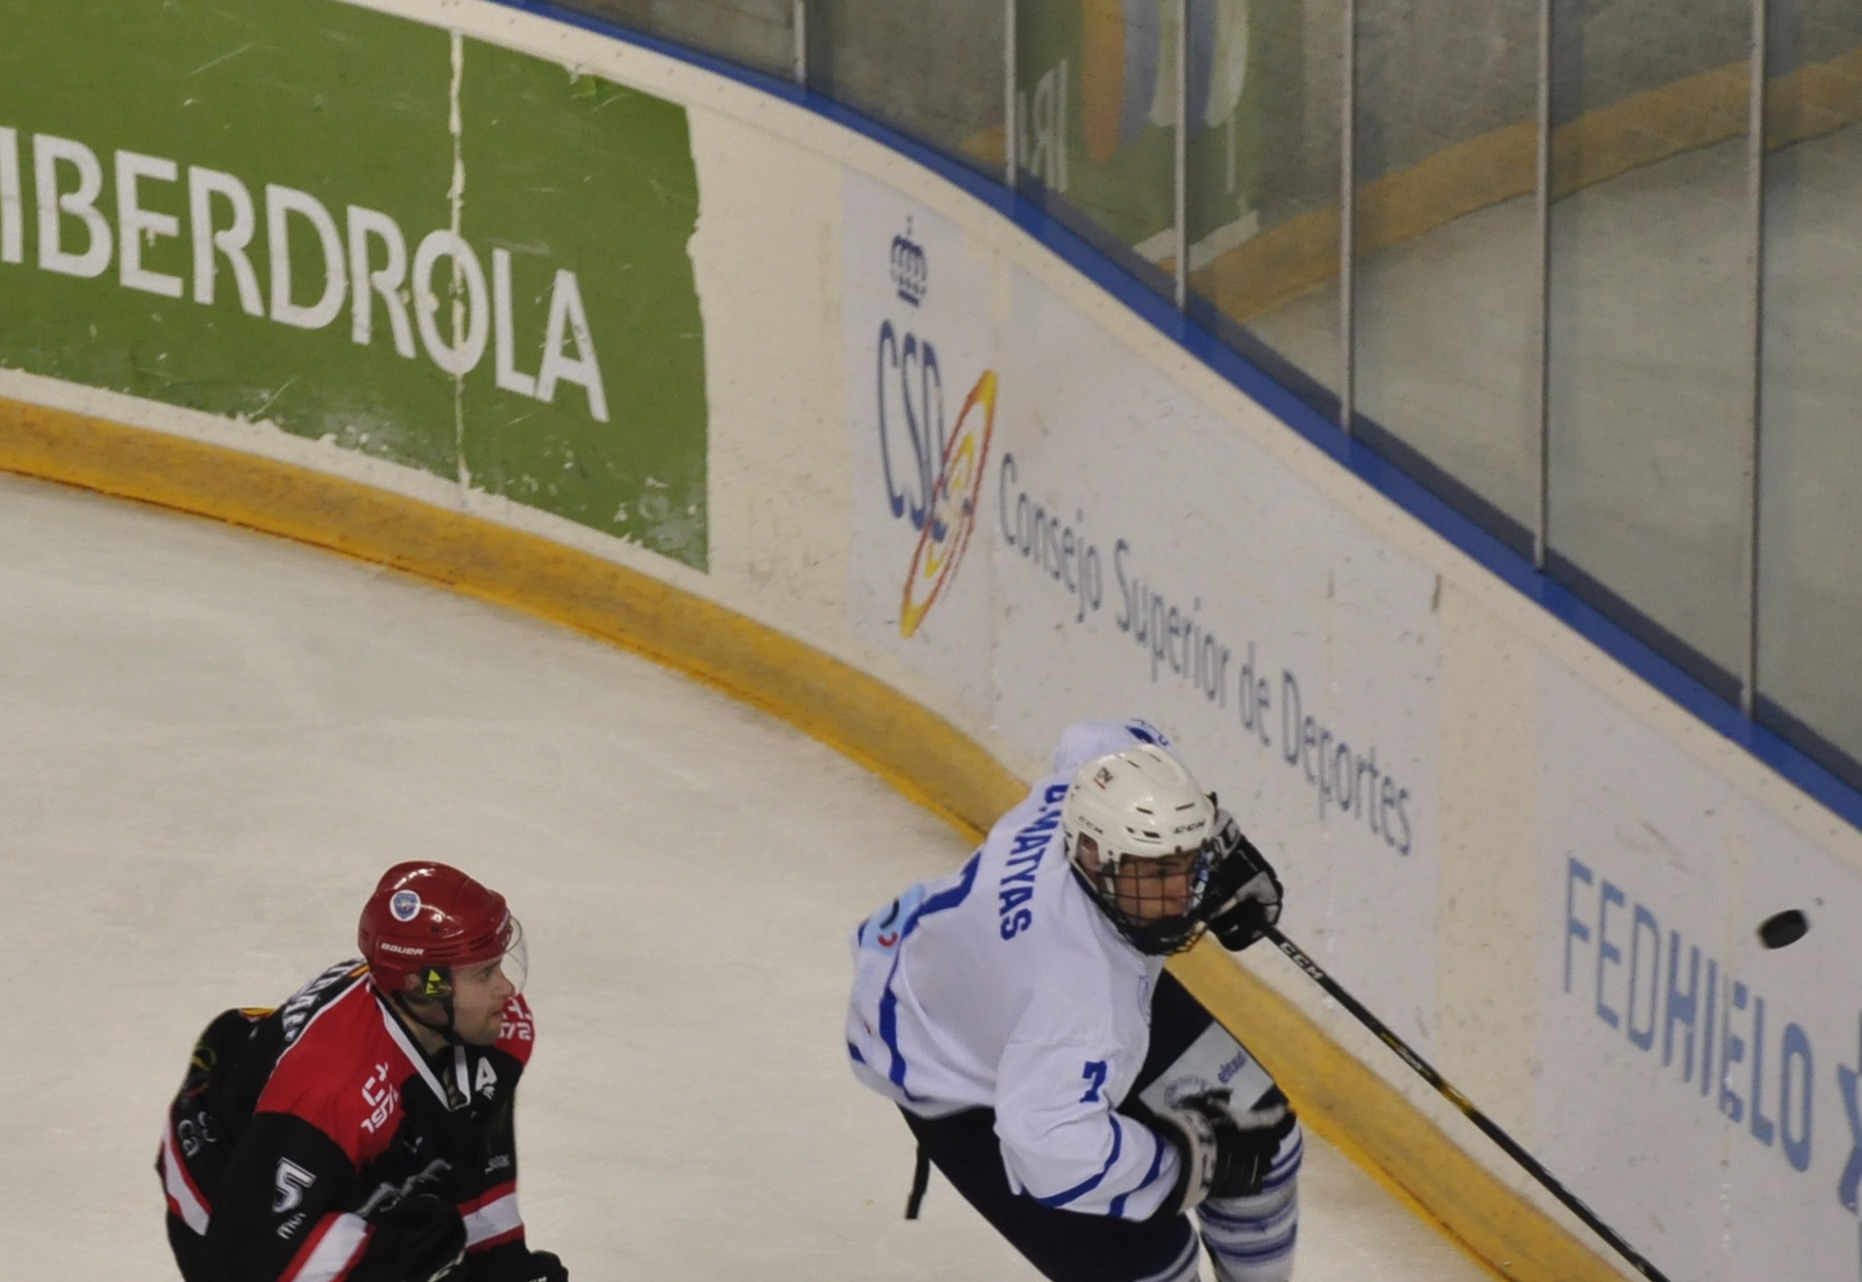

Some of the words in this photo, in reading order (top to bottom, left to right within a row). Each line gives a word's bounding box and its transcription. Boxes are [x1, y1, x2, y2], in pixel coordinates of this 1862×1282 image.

[877, 320, 949, 542] CSD
[1000, 453, 1102, 623] Consejo
[1114, 538, 1230, 708] Superior
[1240, 640, 1271, 747] de
[1282, 668, 1411, 856] Deportes
[381, 943, 424, 955] BAUER
[1280, 941, 1325, 980] CCM
[1564, 857, 1813, 1172] FEDHIELO
[475, 1056, 497, 1092] A
[1079, 1060, 1108, 1103] 7
[272, 1157, 316, 1215] 5
